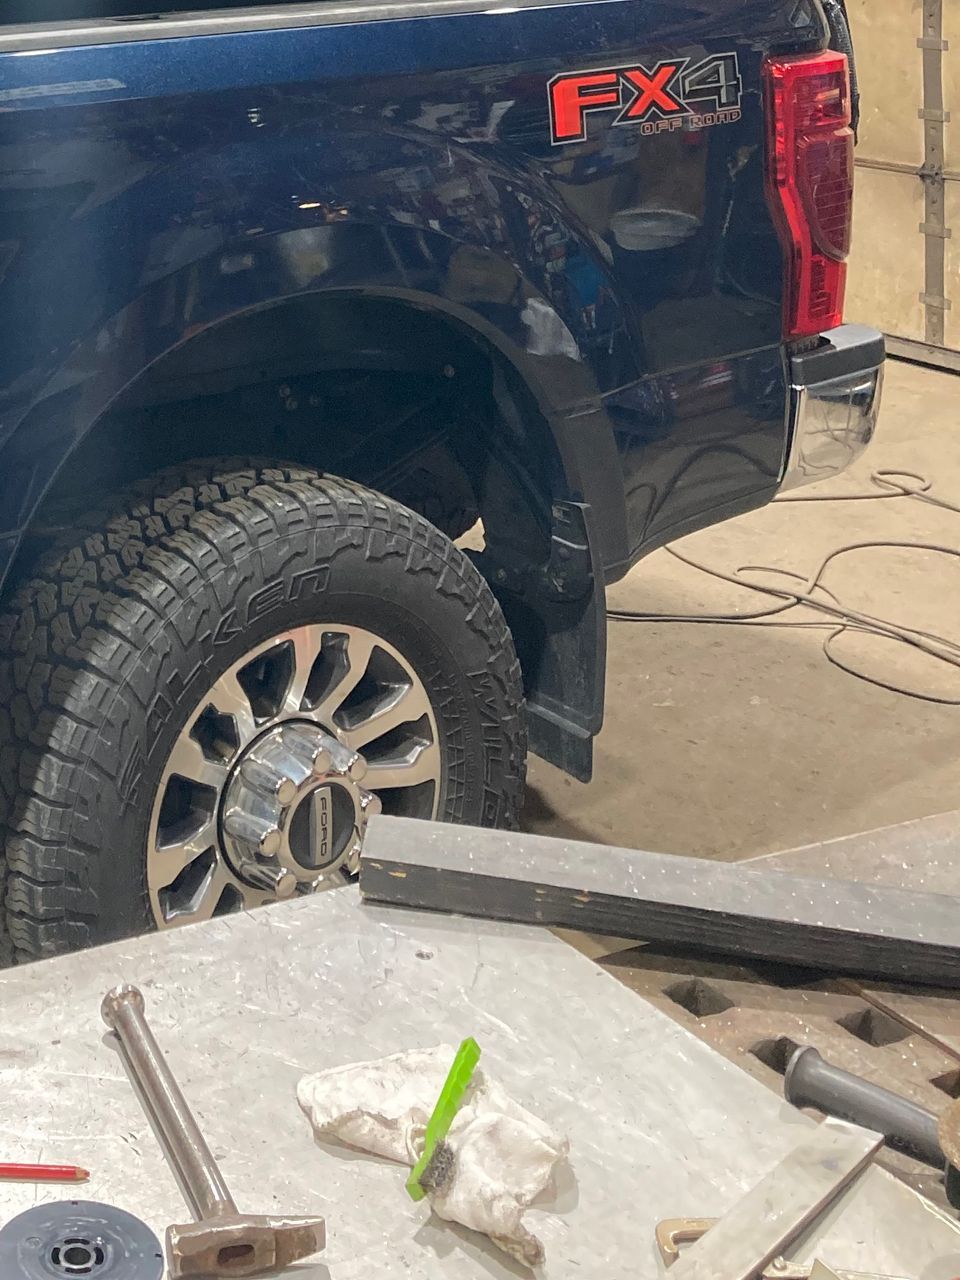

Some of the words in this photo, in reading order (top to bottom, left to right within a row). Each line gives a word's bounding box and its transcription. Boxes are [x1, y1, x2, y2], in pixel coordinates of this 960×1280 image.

[547, 52, 742, 146] FX4
[640, 119, 683, 136] OFF
[689, 109, 742, 129] ROAD
[320, 796, 328, 857] FORD
